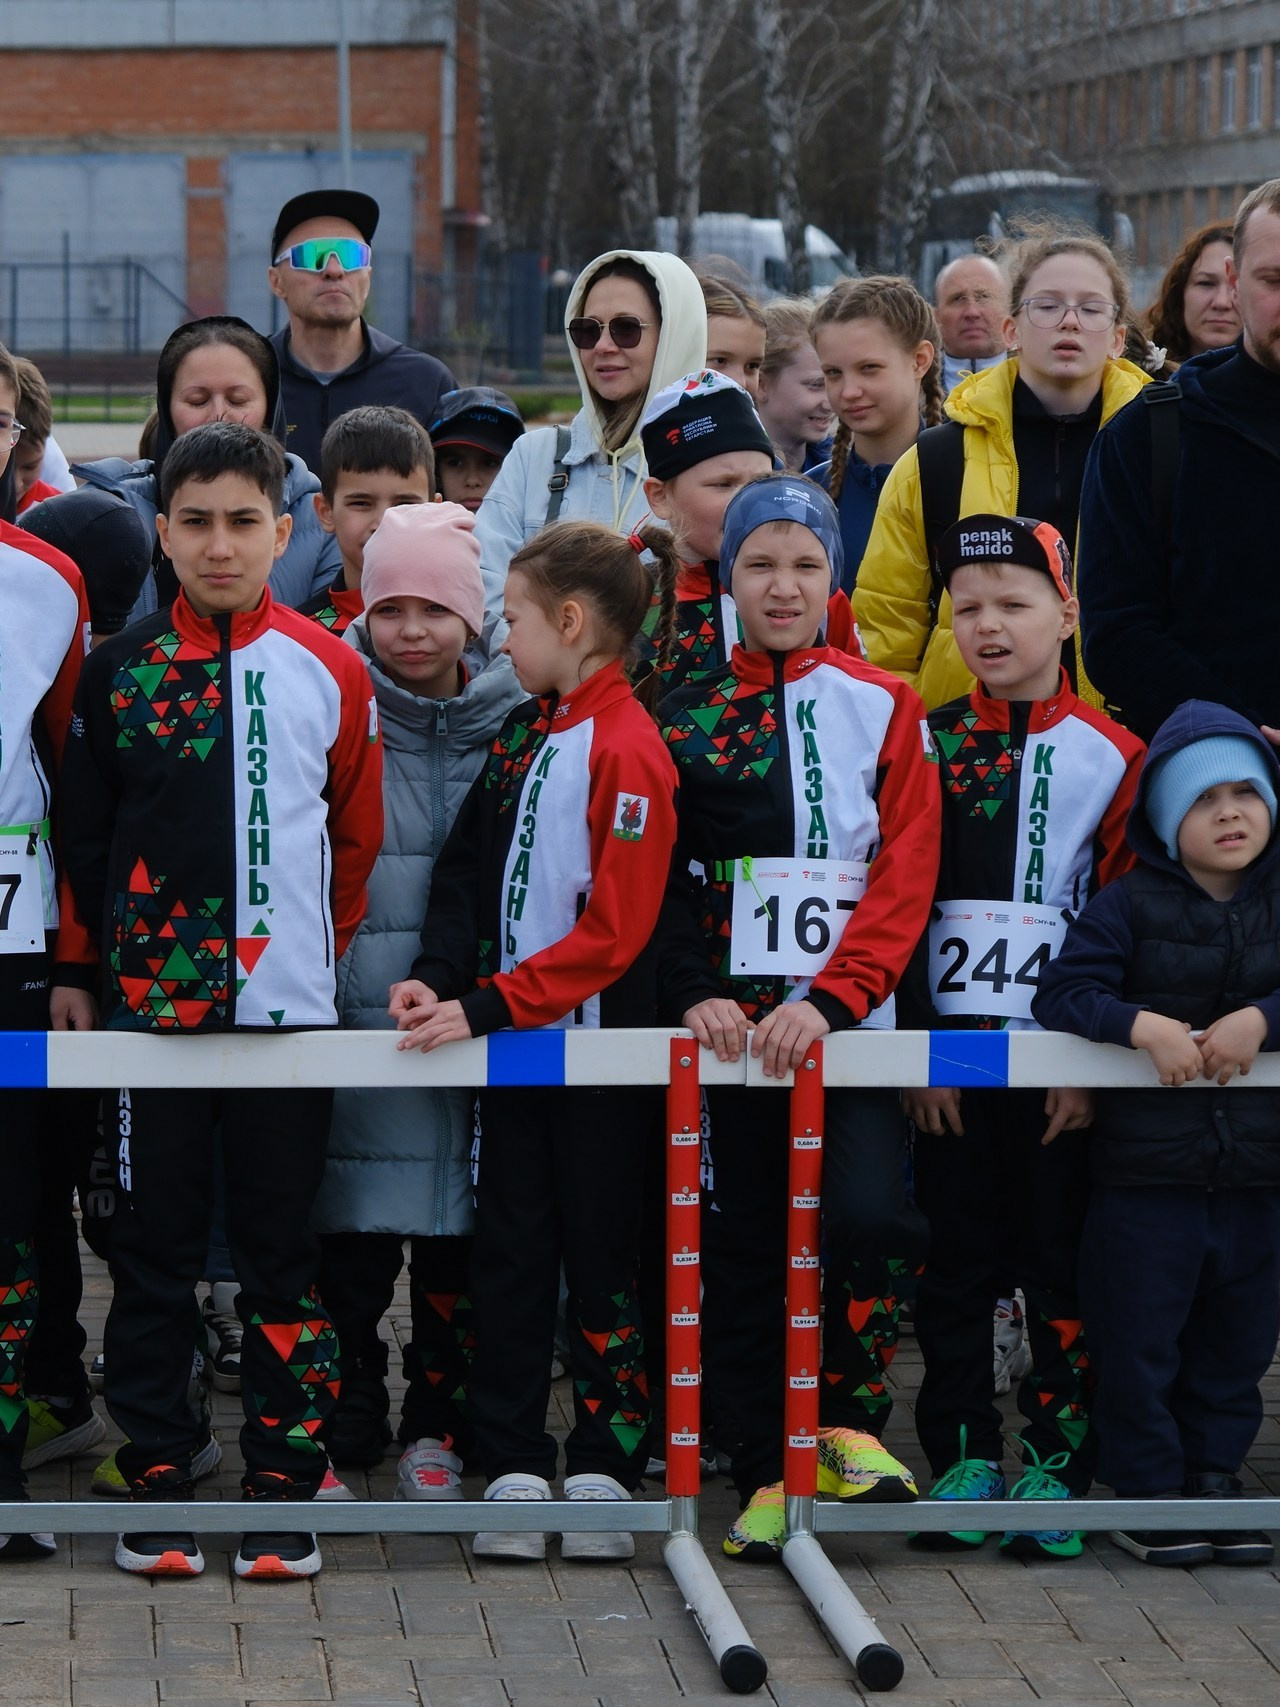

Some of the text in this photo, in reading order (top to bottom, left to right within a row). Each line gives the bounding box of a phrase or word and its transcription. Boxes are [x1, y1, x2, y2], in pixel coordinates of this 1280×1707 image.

[773, 496, 822, 516] NORDSKI
[959, 528, 1014, 547] penak
[960, 541, 1013, 557] maido
[243, 670, 271, 907] КАЗАНЬ
[795, 698, 830, 859] КАЗАН
[505, 745, 561, 957] КАЗАНЬ
[1024, 742, 1054, 905] КАЗАН
[1034, 918, 1056, 927] СМУ-88
[937, 937, 1051, 994] 244
[117, 1088, 133, 1193] АЗАН
